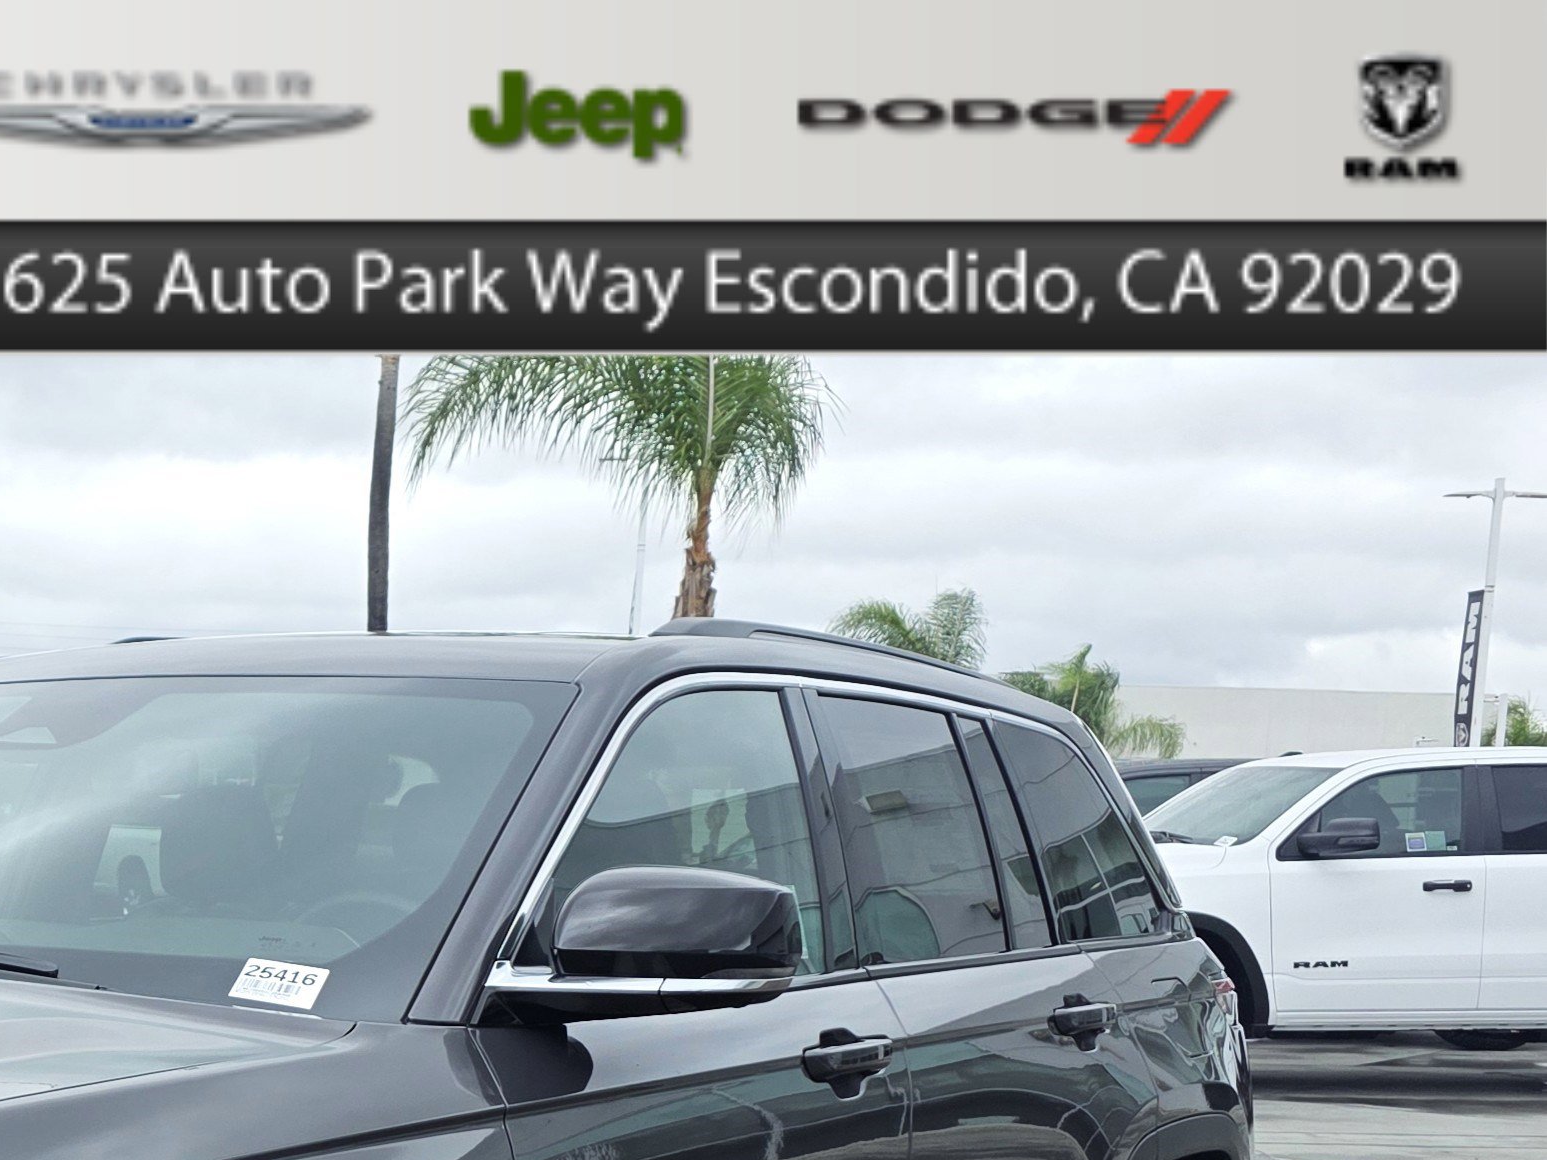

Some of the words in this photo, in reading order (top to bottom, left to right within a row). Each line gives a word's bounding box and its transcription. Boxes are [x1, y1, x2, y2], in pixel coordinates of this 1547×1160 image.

[1457, 602, 1481, 715] RAM
[244, 964, 319, 986] 25416
[1293, 960, 1349, 969] RAM
